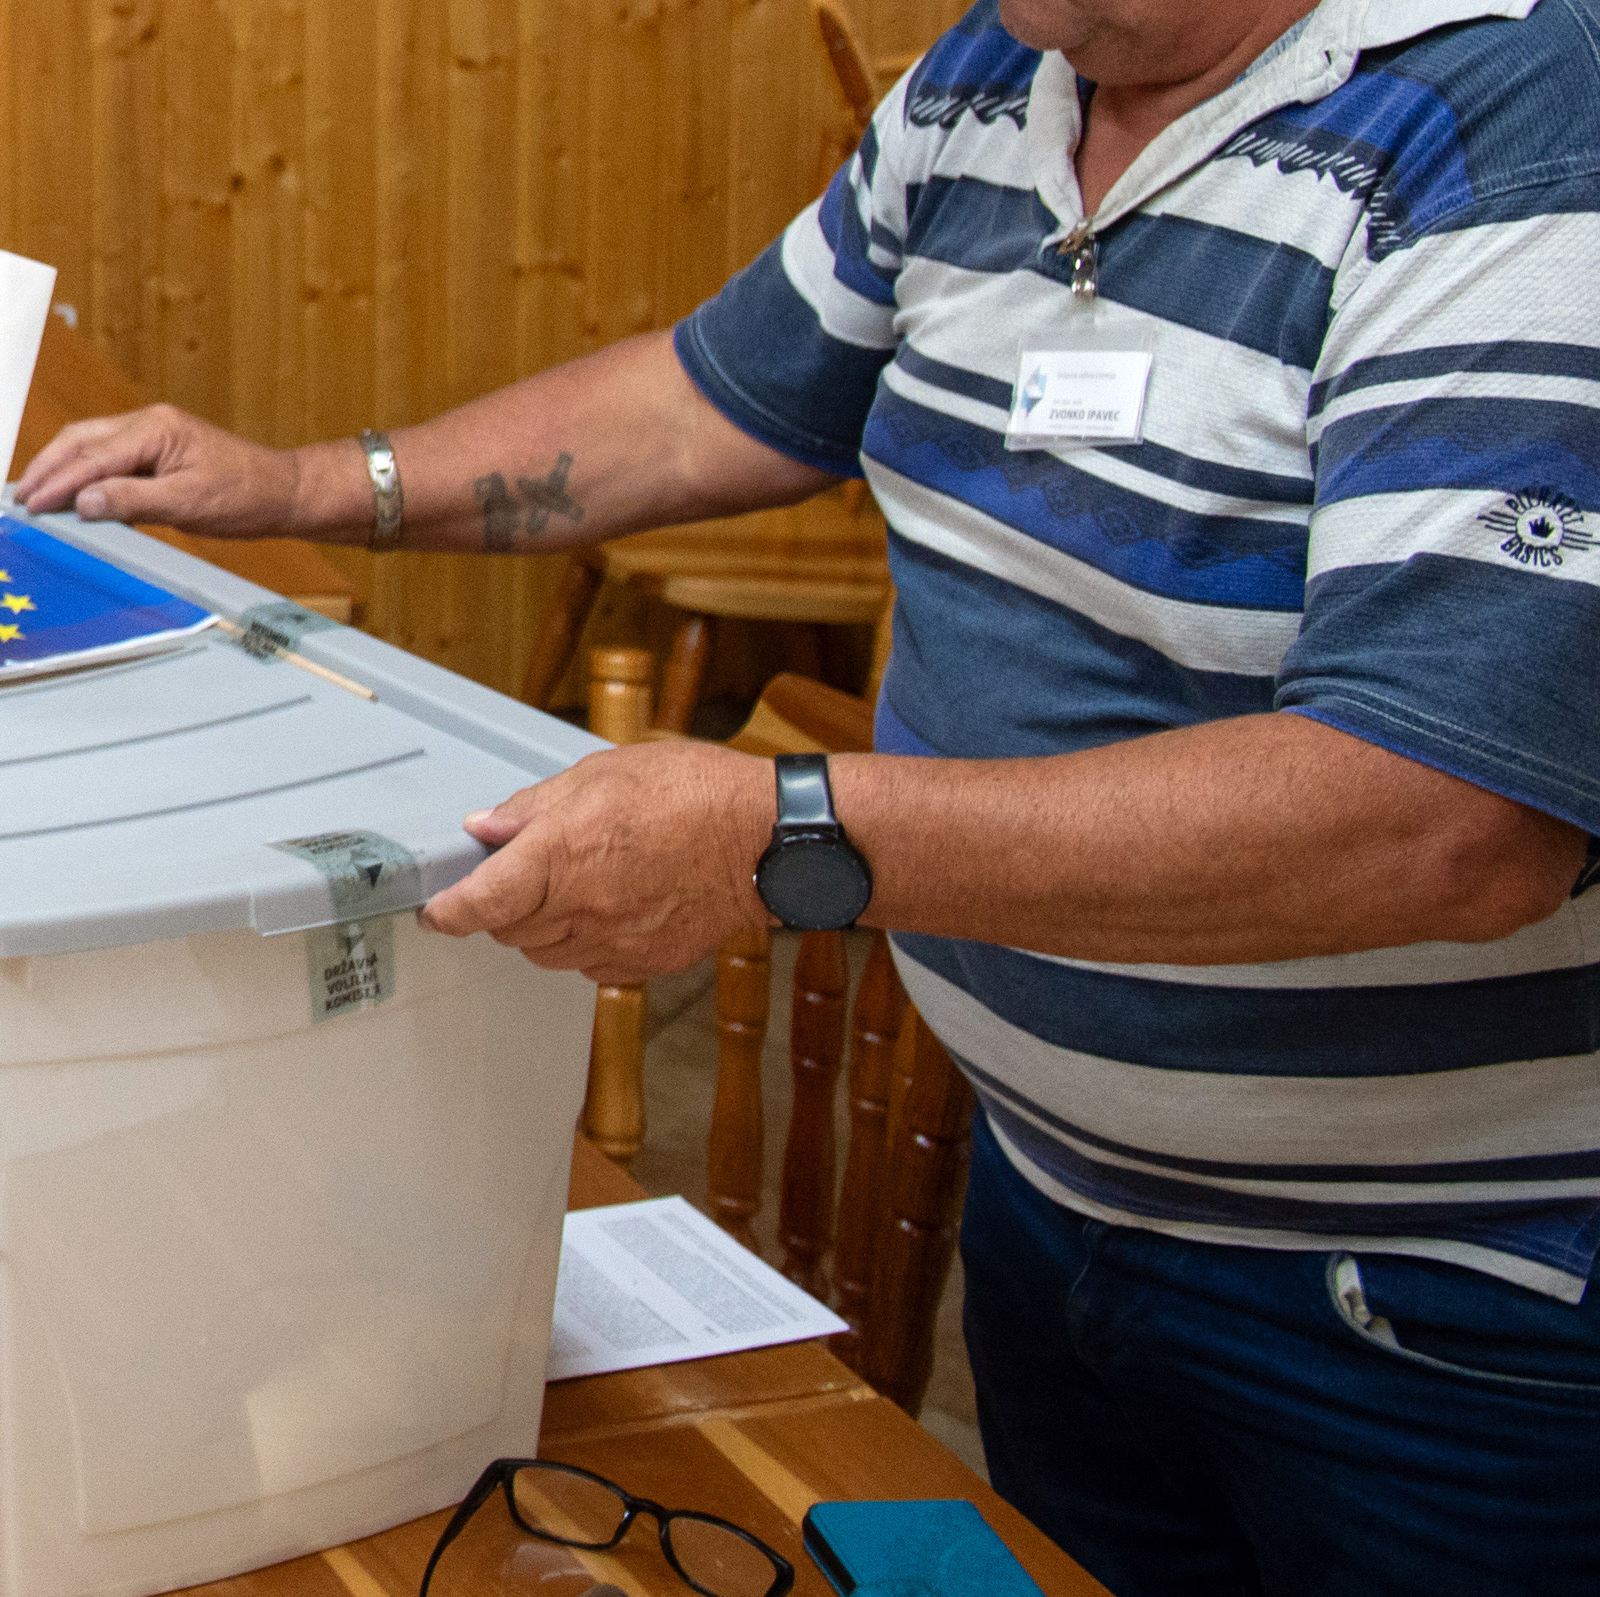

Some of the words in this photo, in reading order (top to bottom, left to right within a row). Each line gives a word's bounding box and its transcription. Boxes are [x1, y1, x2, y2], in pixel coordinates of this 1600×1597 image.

[1049, 408, 1085, 420] ZVONKO
[1087, 409, 1120, 421] IPAVEC
[1500, 534, 1563, 567] BASICS
